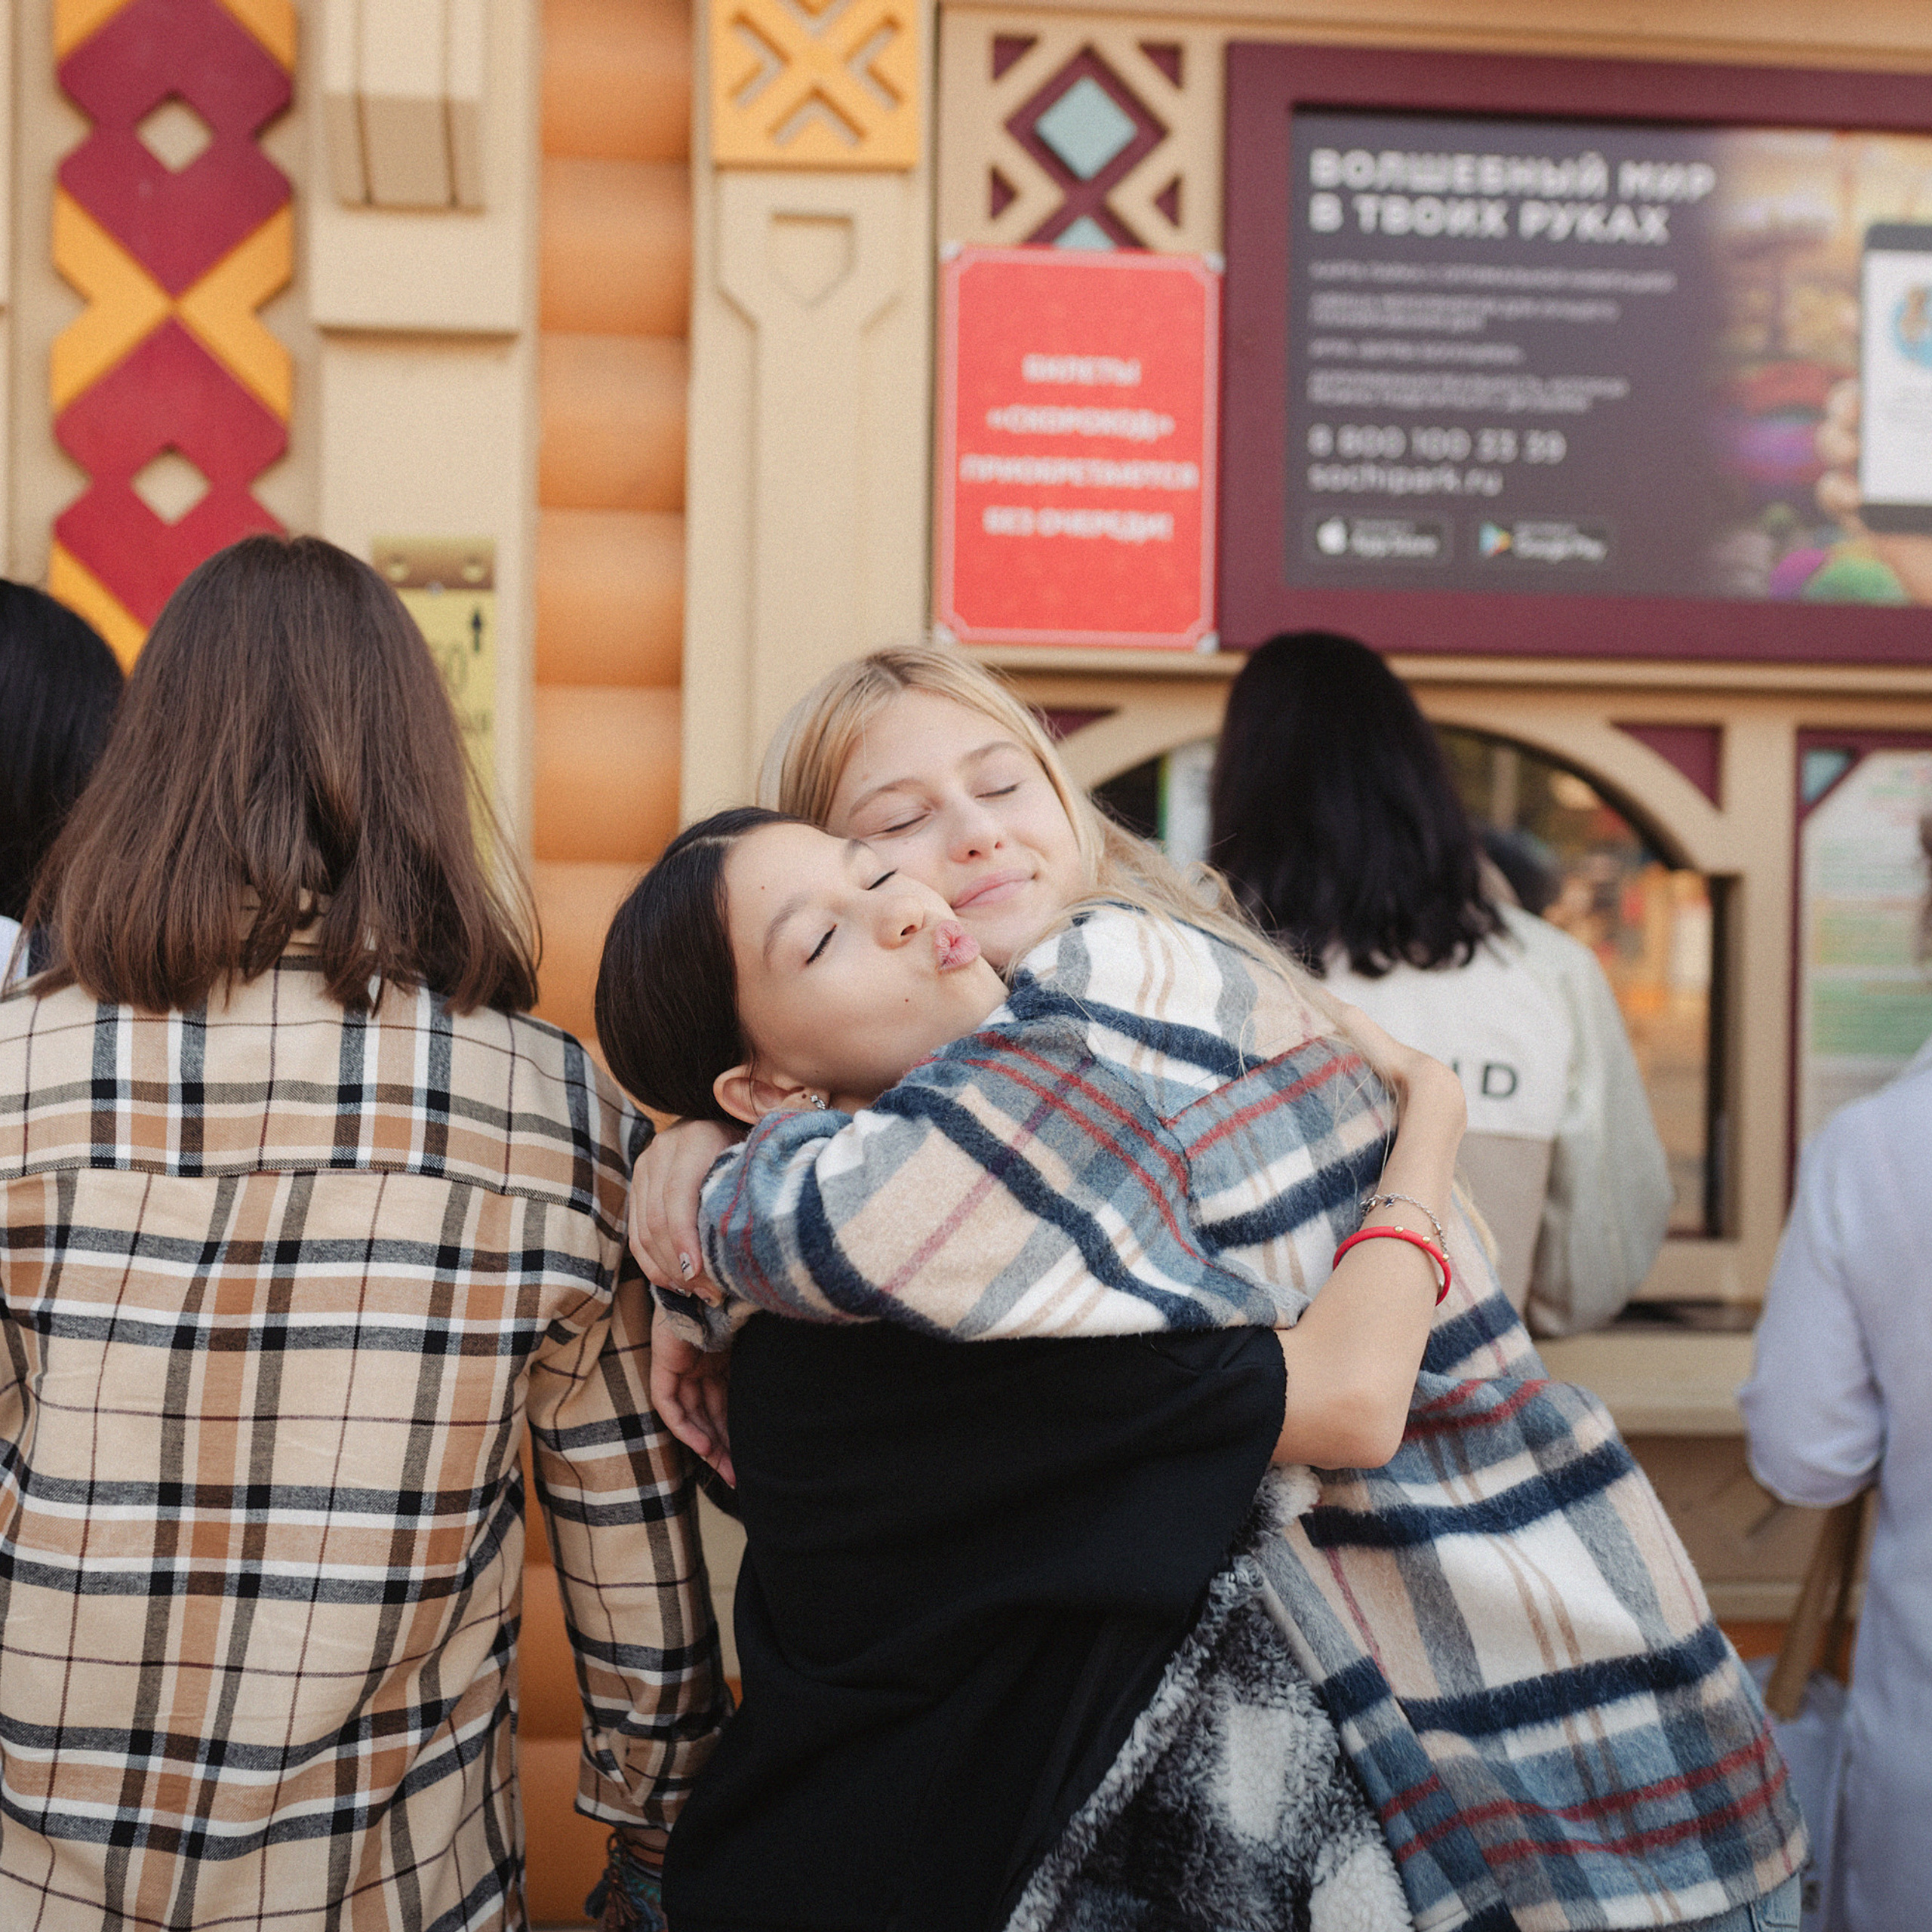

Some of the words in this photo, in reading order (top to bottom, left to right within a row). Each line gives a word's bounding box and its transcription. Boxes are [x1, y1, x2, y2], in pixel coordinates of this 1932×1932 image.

[1310, 149, 1608, 200] ВОЛШЕБНЫЙ
[1618, 160, 1716, 202] МИР
[1310, 192, 1343, 233] В
[1352, 194, 1509, 238] ТВОИХ
[1518, 199, 1669, 244] РУКАХ
[1308, 424, 1334, 457] 8
[1337, 424, 1406, 458] 800
[1412, 426, 1471, 460] 100
[1475, 428, 1518, 463] 33
[1308, 463, 1503, 496] sochipark.ru
